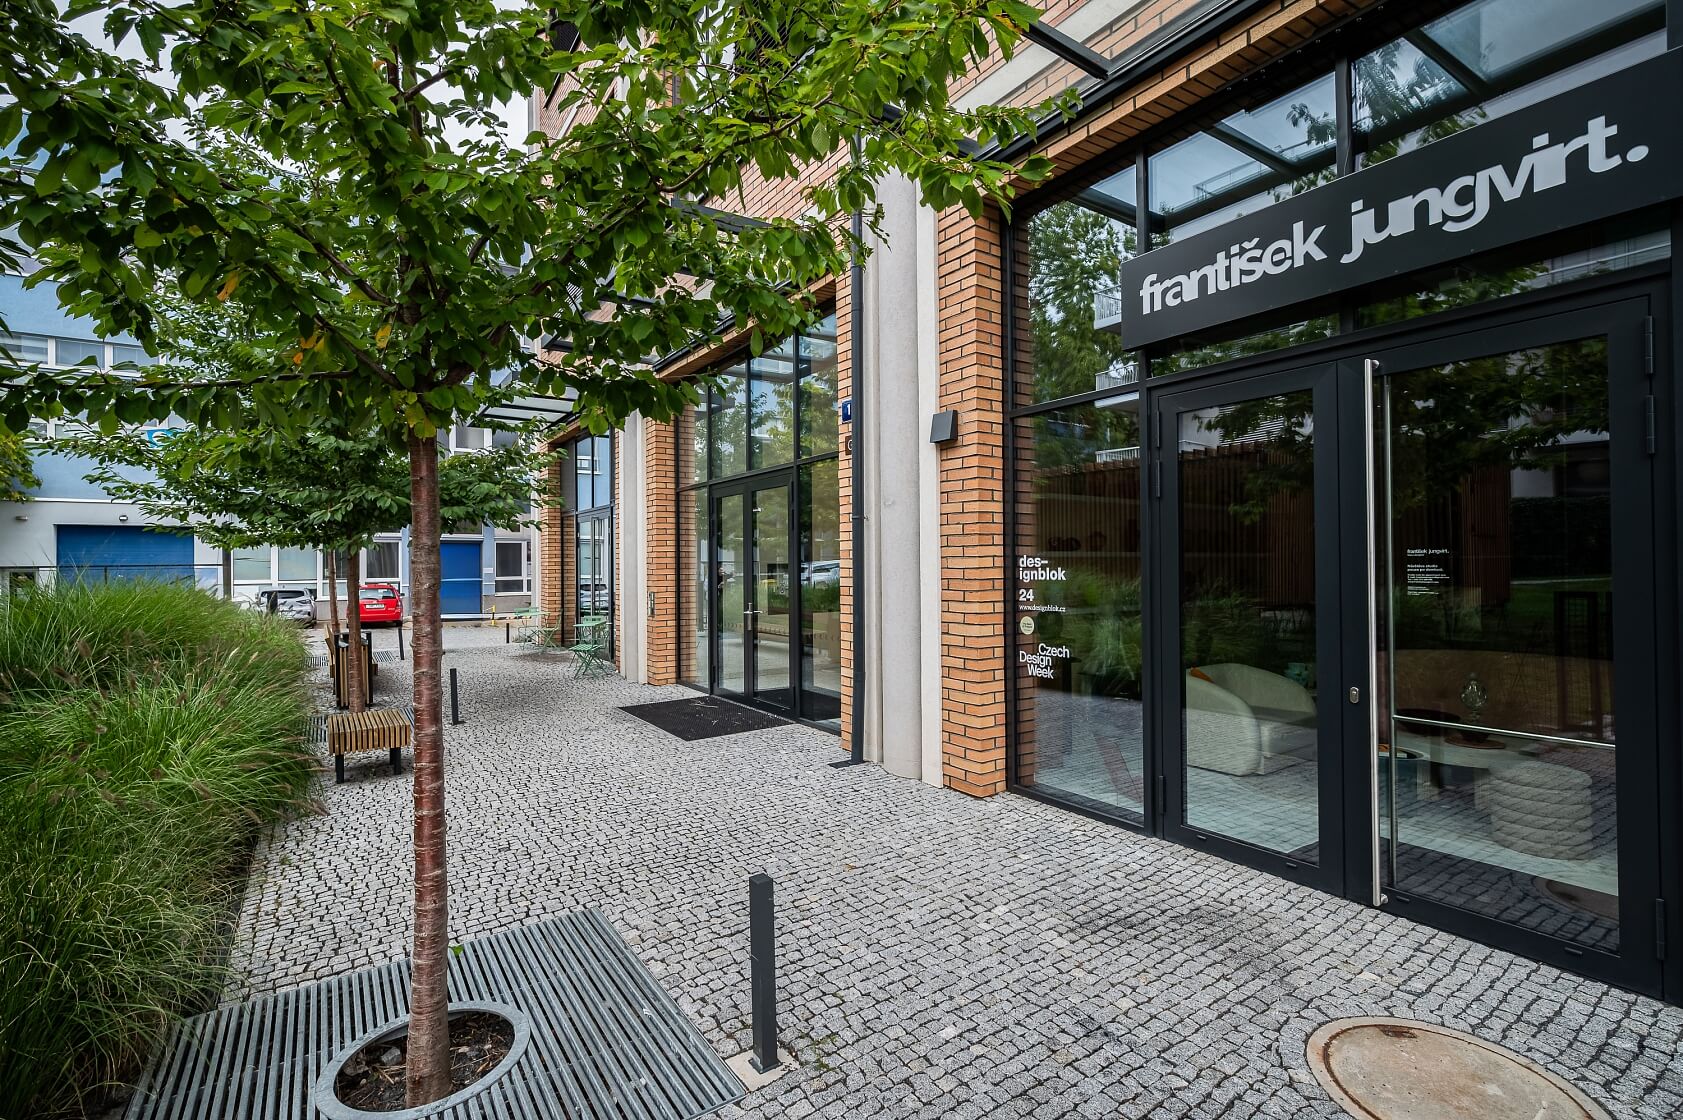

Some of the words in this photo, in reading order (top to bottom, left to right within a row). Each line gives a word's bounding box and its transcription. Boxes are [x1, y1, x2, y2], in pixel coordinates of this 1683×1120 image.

[1140, 221, 1327, 314] františek
[1340, 115, 1649, 263] jungvirt.
[1019, 555, 1048, 568] des-
[1019, 568, 1066, 582] ignblok
[1019, 589, 1034, 601] 24
[1019, 604, 1066, 612] www.designblok.cz
[1038, 643, 1070, 658] Czech
[1019, 651, 1052, 667] Design
[1027, 664, 1054, 679] Week
